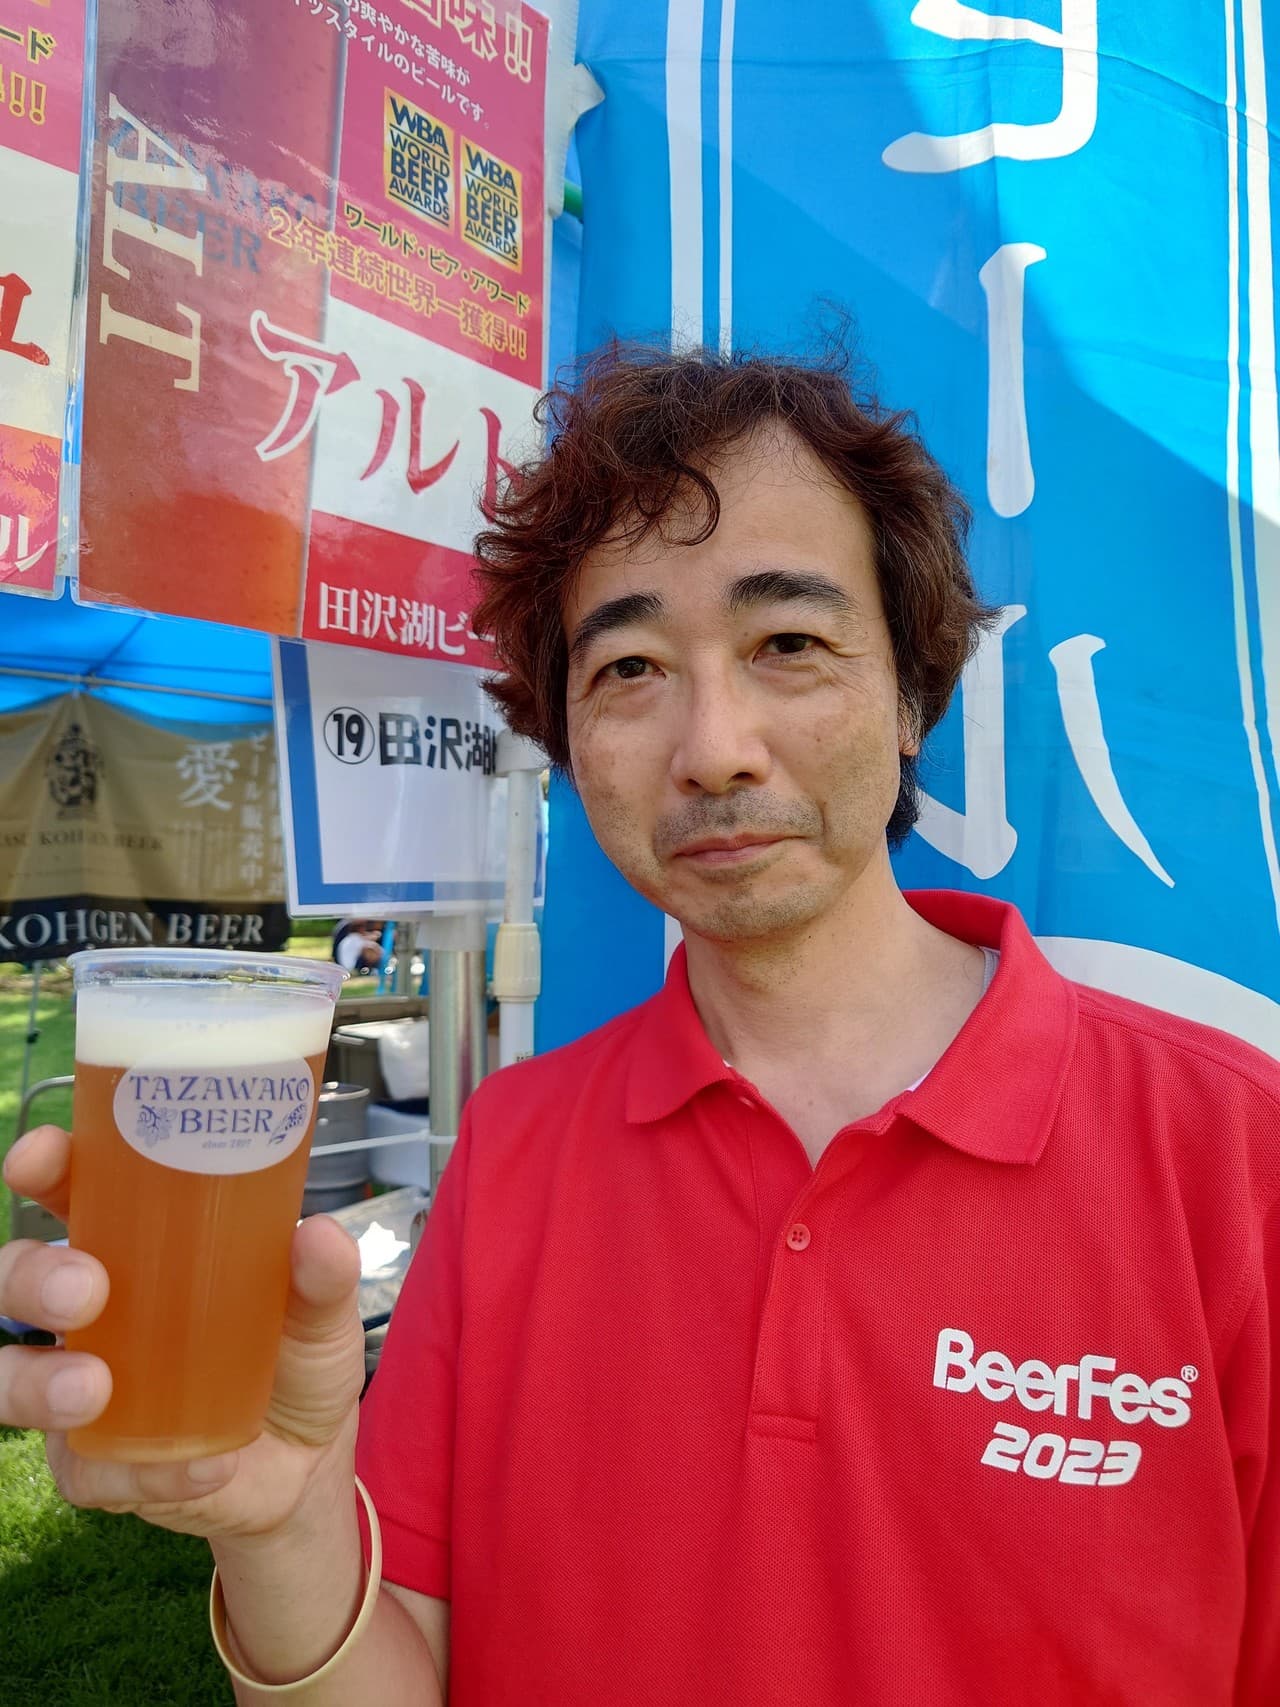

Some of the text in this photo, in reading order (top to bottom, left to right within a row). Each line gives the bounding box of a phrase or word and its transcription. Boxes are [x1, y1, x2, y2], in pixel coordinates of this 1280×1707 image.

[295, 0, 490, 129] ツスタイルのビールです。
[390, 95, 449, 155] WBA
[390, 129, 450, 177] WORLD
[391, 147, 448, 206] BEER
[465, 143, 518, 198] WBA
[389, 177, 449, 221] AWARDS
[465, 173, 518, 218] WORLD
[466, 193, 517, 244] BEER
[98, 92, 207, 393] ALT
[465, 219, 518, 260] AWARDS
[250, 309, 523, 525] アルト
[175, 741, 240, 810] 愛
[167, 912, 264, 944] BEER
[129, 1075, 310, 1102] TAZAWAKO
[179, 1108, 273, 1134] BEER
[980, 1421, 1142, 1486] 2023
